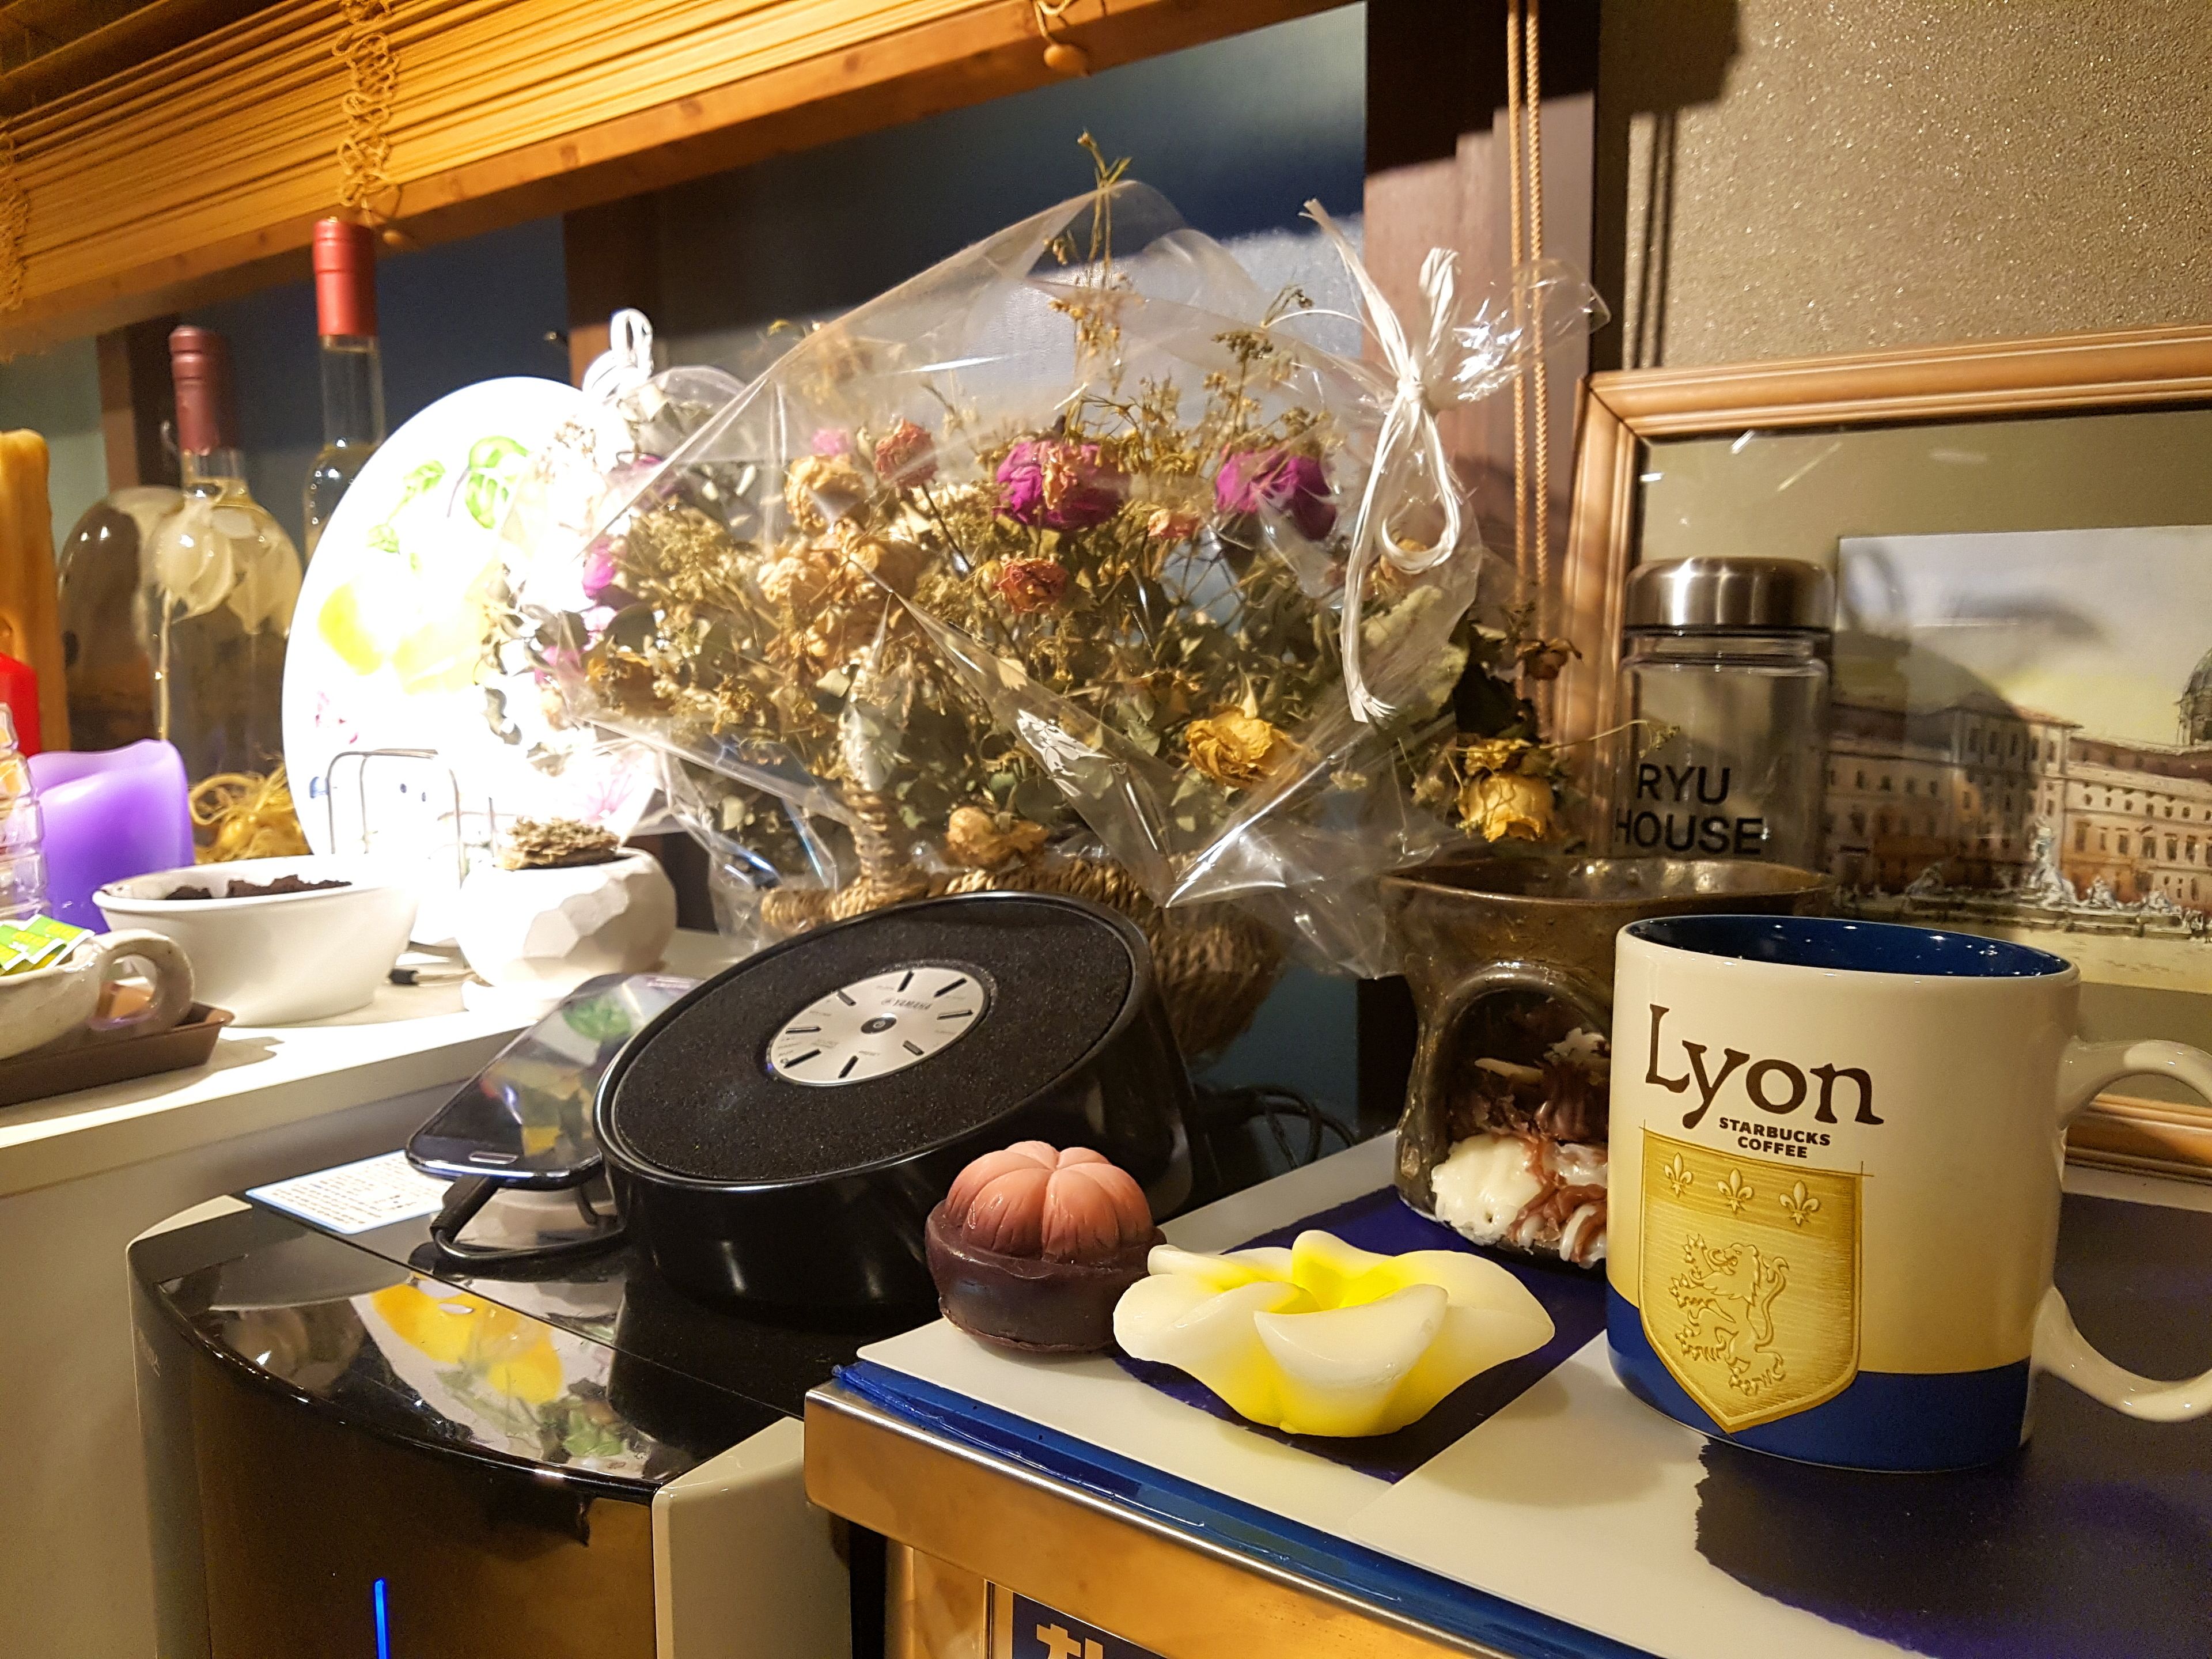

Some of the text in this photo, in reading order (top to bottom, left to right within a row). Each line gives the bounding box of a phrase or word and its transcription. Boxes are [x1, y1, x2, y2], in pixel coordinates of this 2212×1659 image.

[1636, 763, 1730, 805] RYU
[1614, 808, 1764, 855] HOUSE
[1645, 1003, 1884, 1130] Lyon
[1719, 1116, 1831, 1146] STARBUCKS
[1737, 1135, 1808, 1158] COFFEE
